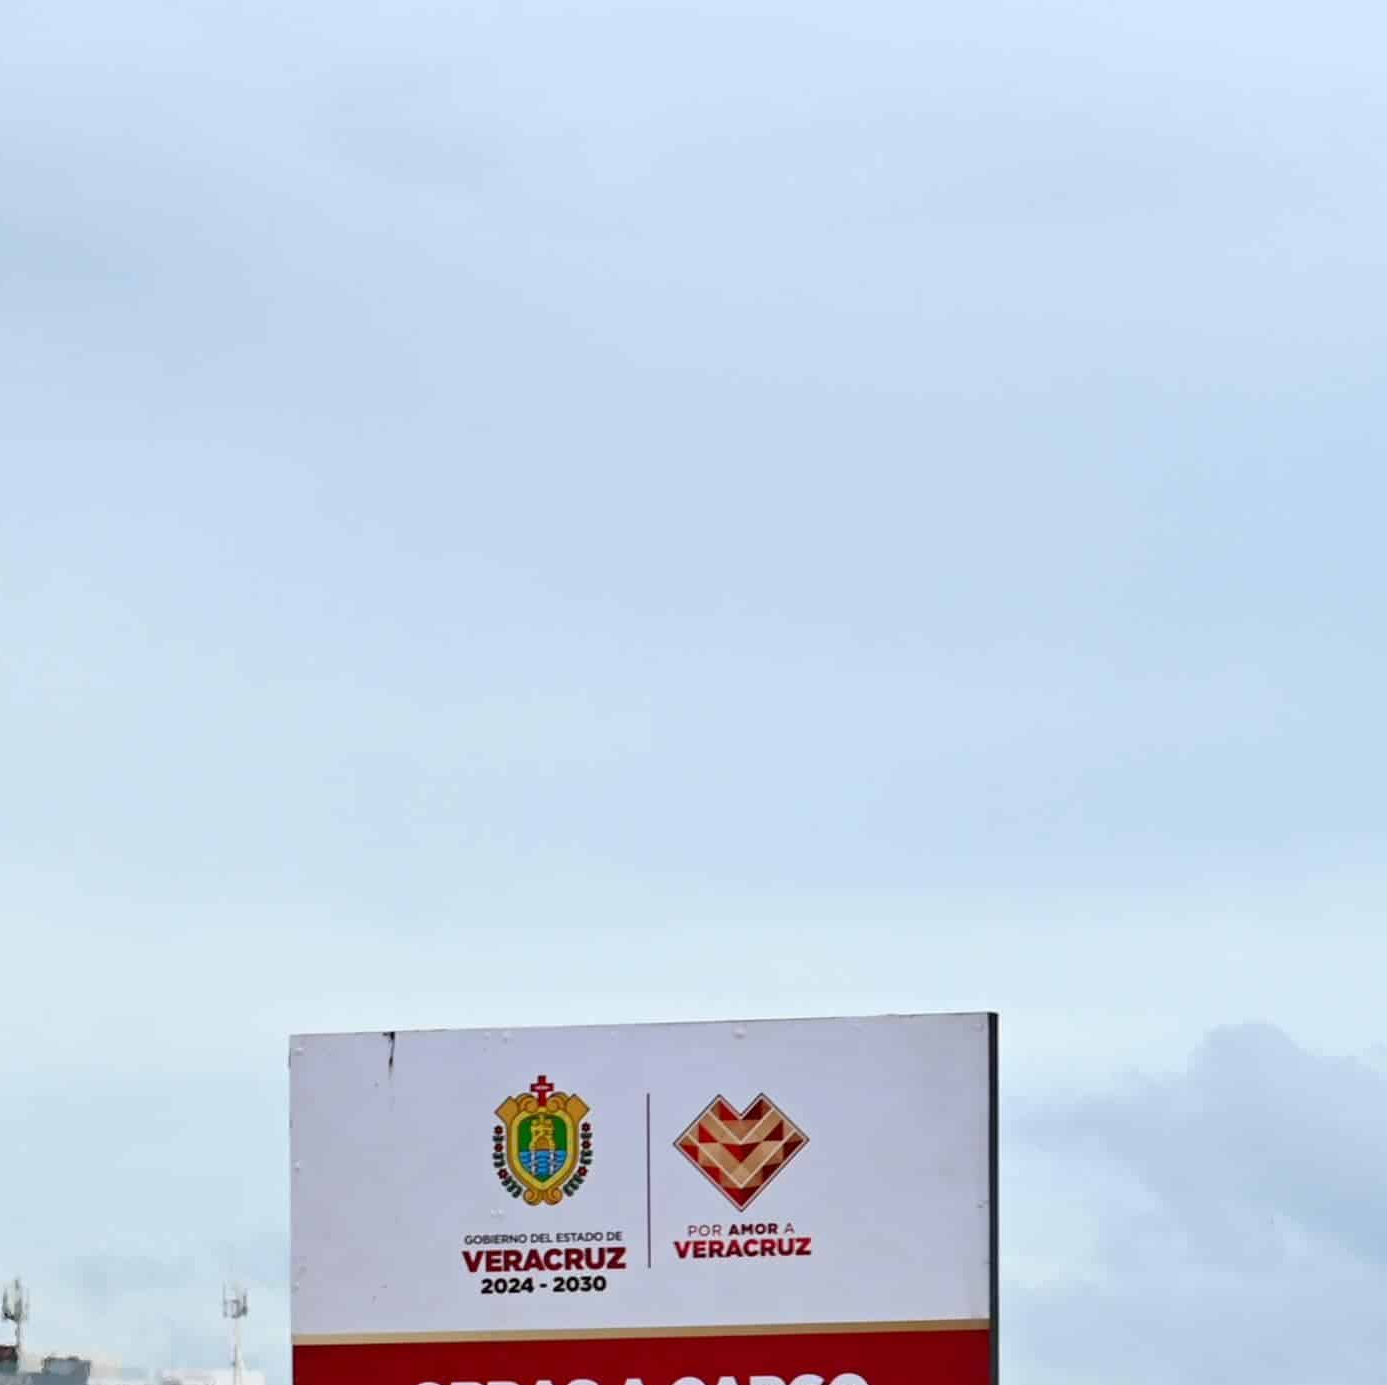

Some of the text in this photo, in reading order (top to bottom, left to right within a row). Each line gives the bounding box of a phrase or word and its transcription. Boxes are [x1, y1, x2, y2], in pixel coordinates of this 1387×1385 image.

[464, 1231, 622, 1245] GOBIERNO DEL ESTADO DE
[688, 1222, 795, 1237] POR AMOR A
[673, 1237, 812, 1259] VERACRUZ
[462, 1247, 626, 1273] VERACRUZ
[481, 1278, 534, 1294] 2024
[553, 1276, 607, 1292] 2030
